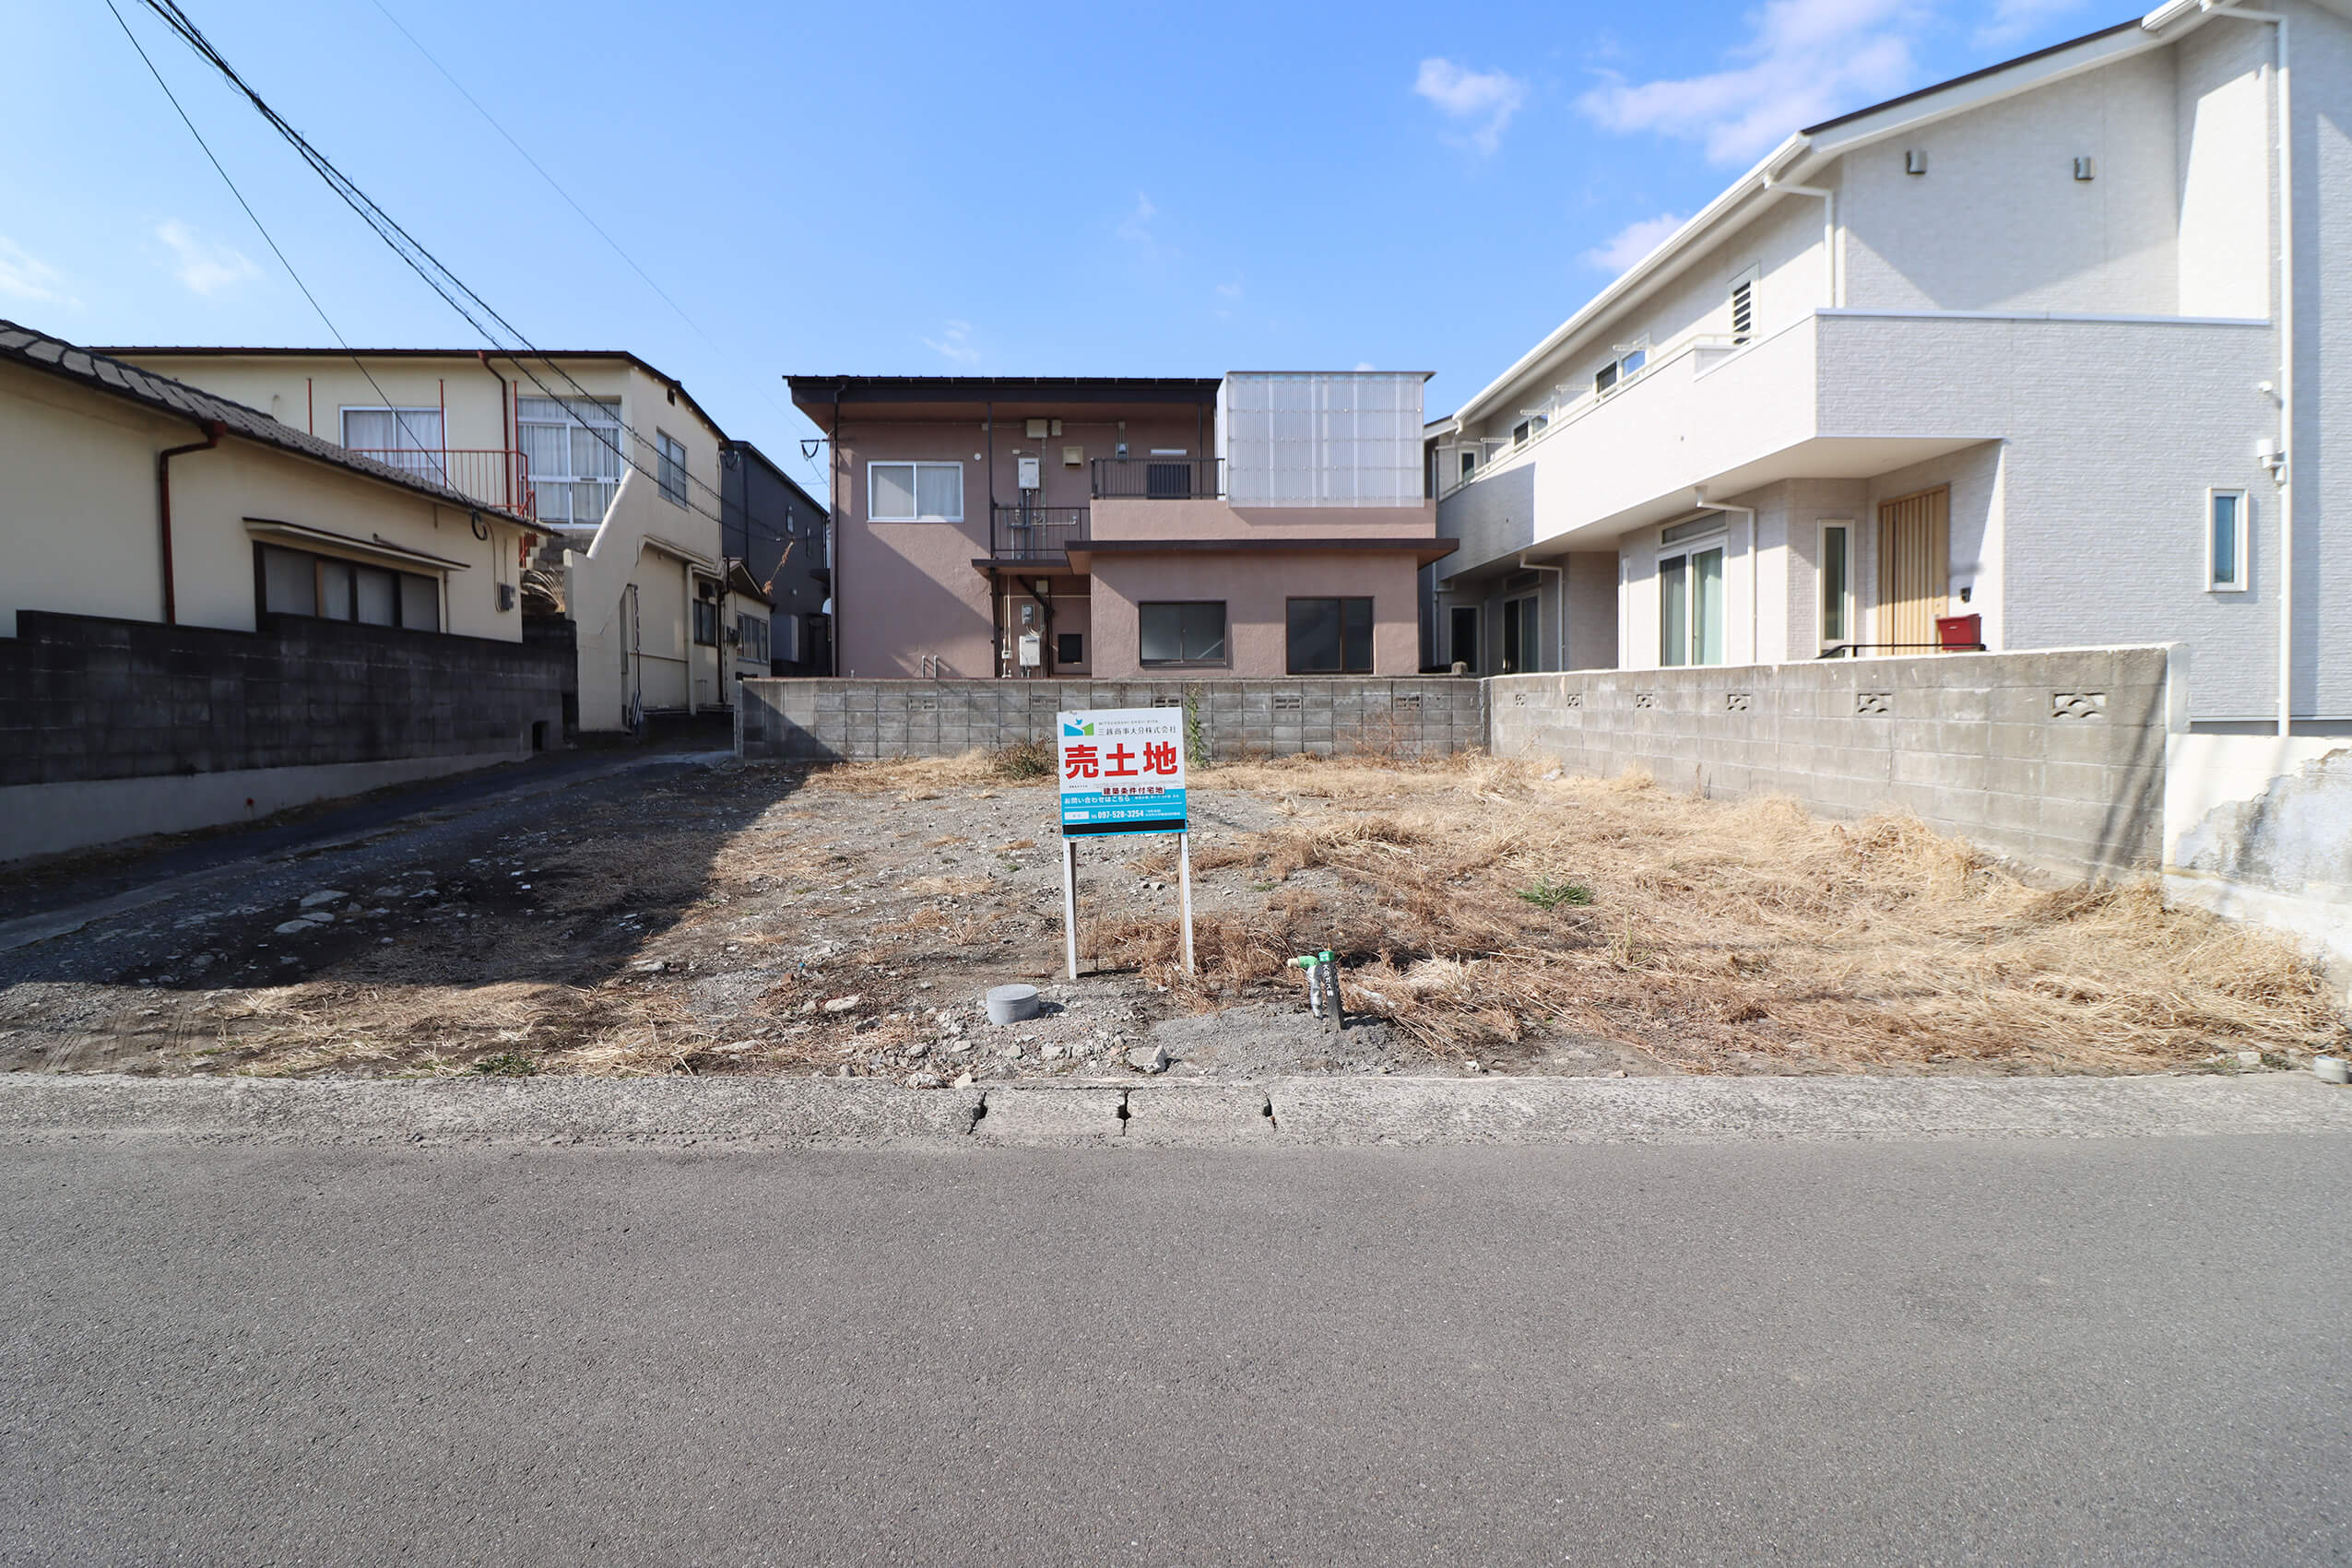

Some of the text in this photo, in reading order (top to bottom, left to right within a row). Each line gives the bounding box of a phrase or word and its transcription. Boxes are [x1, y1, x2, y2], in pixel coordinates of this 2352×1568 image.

[1065, 741, 1178, 779] 売土地
[1104, 786, 1164, 795] 建築条件付宅地
[1064, 796, 1130, 804] お問い合わせはこちら
[1097, 809, 1144, 819] 097-528-3254
